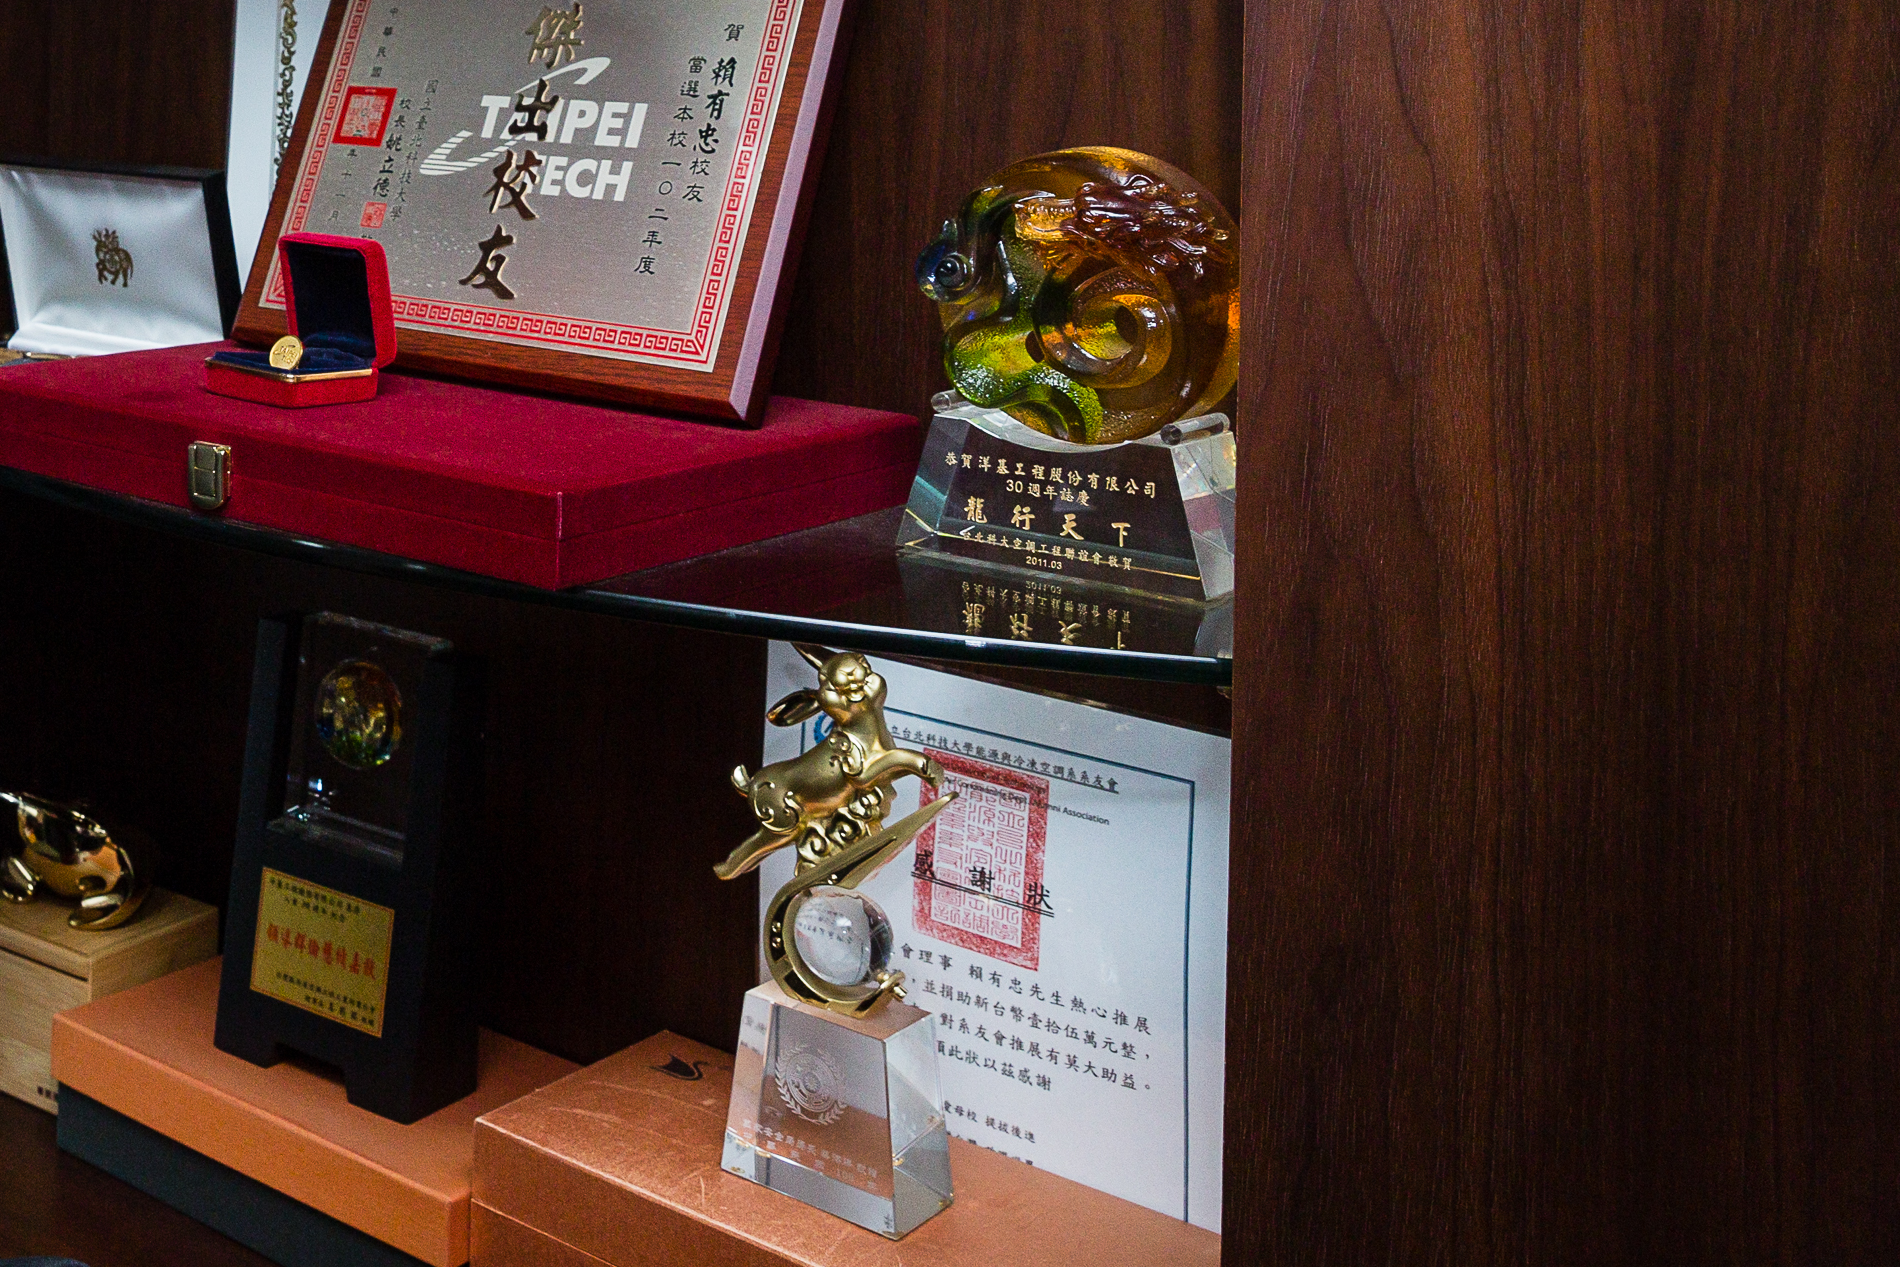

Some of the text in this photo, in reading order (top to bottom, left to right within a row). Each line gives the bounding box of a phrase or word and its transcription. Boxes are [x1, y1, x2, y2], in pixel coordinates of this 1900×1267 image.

[480, 95, 648, 148] TAIPEI
[390, 79, 439, 221] 國立臺北科技大學
[458, 0, 584, 300] 傑出校友
[520, 154, 633, 201] TECH
[964, 496, 1131, 547] 龍行天下
[1026, 556, 1062, 569] 2011.03
[1062, 806, 1110, 826] Association
